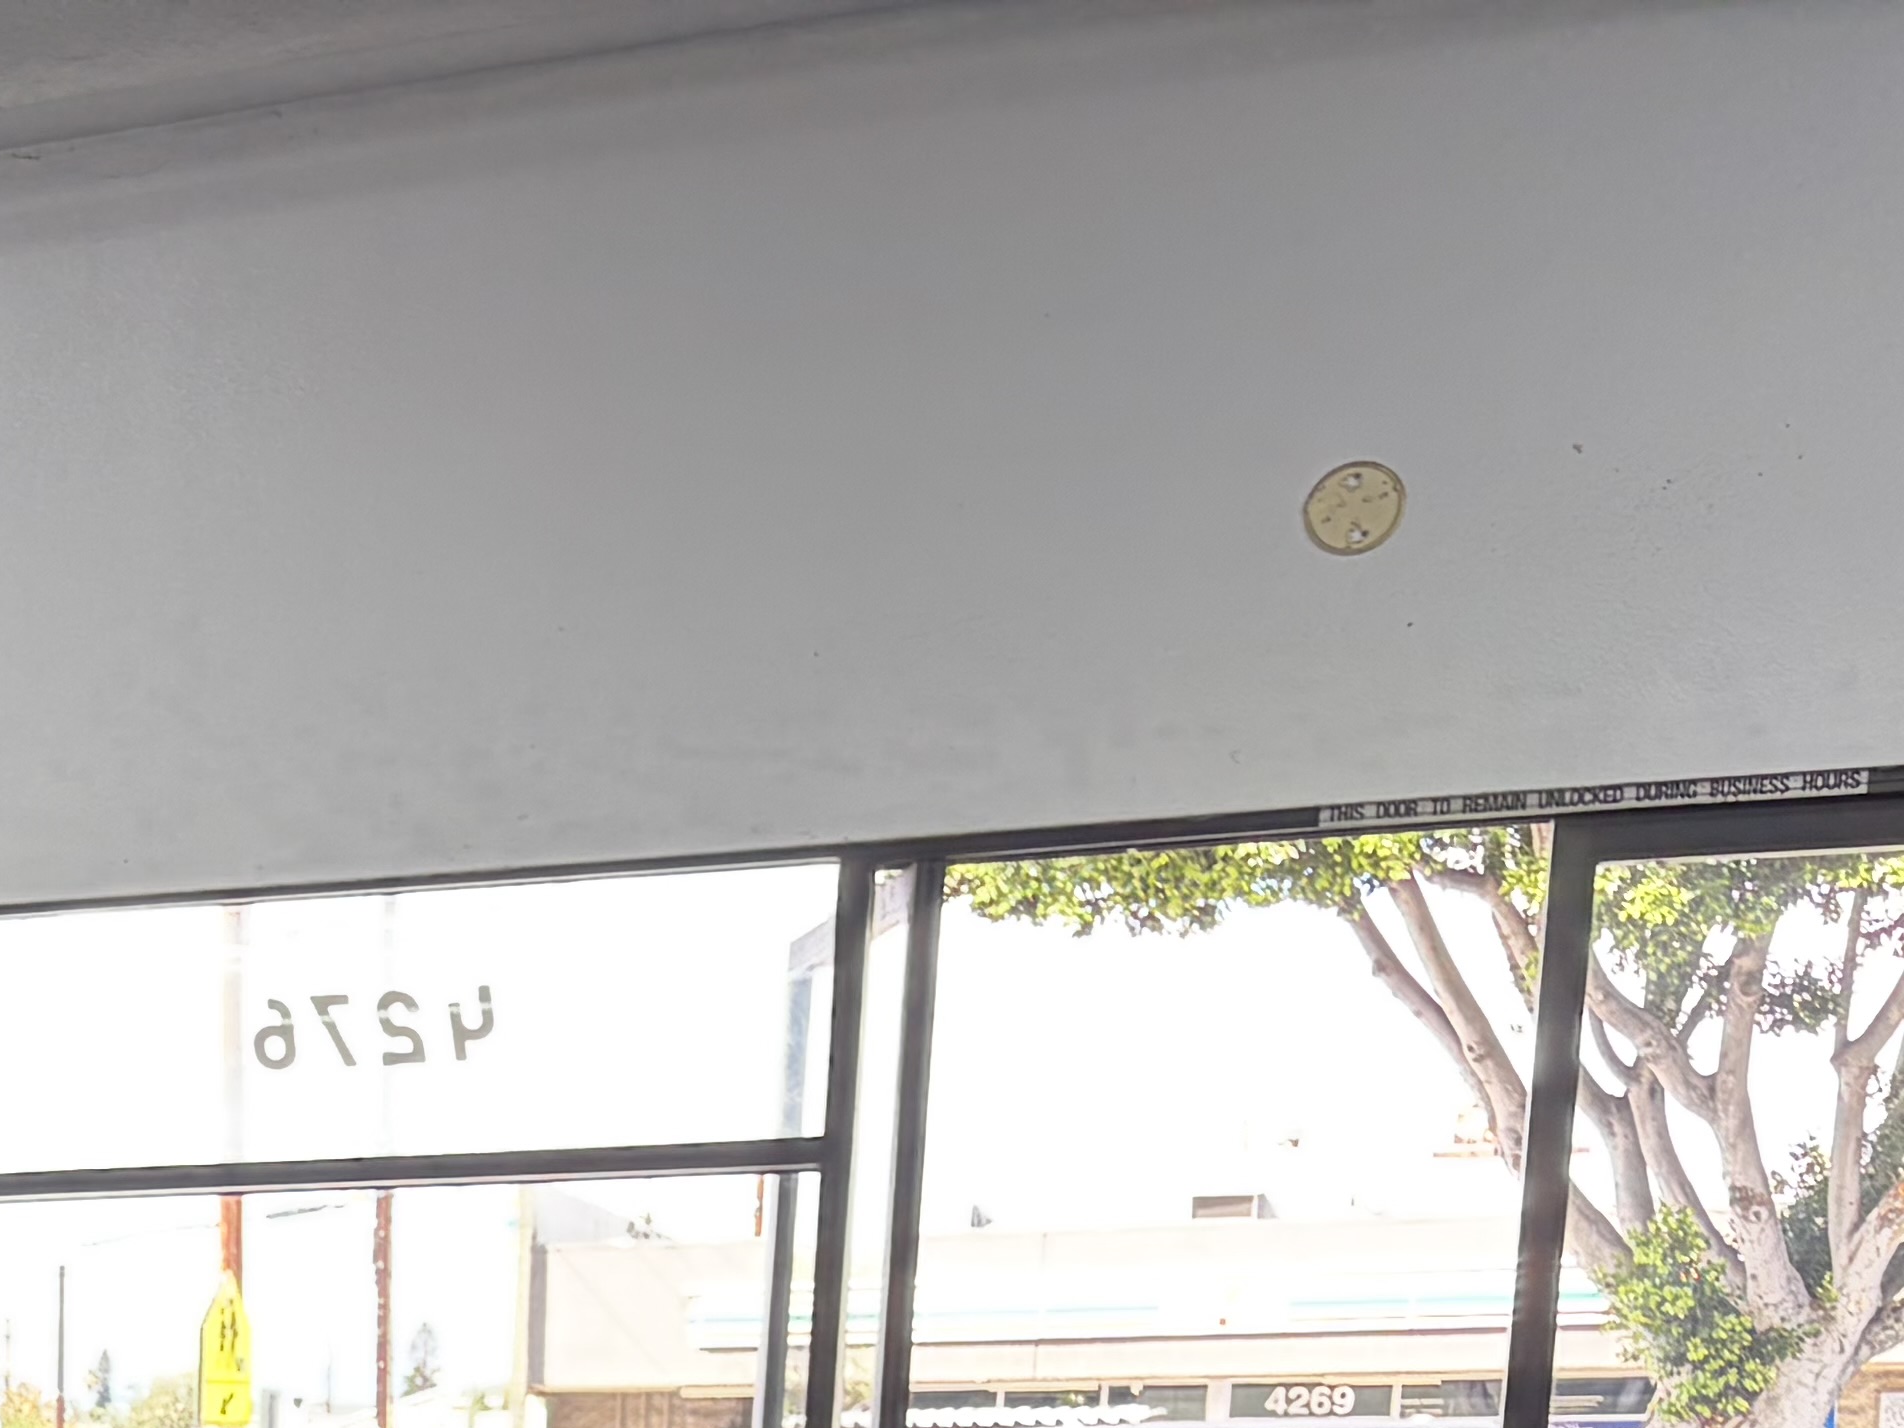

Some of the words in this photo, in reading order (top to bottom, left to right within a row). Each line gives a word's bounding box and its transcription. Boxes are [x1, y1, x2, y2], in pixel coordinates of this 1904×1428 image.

[1328, 804, 1365, 823] THIS
[1375, 800, 1418, 819] DOOR
[1431, 798, 1451, 815] TO
[1462, 792, 1527, 814] REMAIN
[1538, 786, 1624, 809] UNLOCKED
[1635, 780, 1698, 802] DURING
[1709, 776, 1791, 798] BUSINESS
[1802, 771, 1862, 792] HOURS
[1264, 1385, 1355, 1416] 4269
